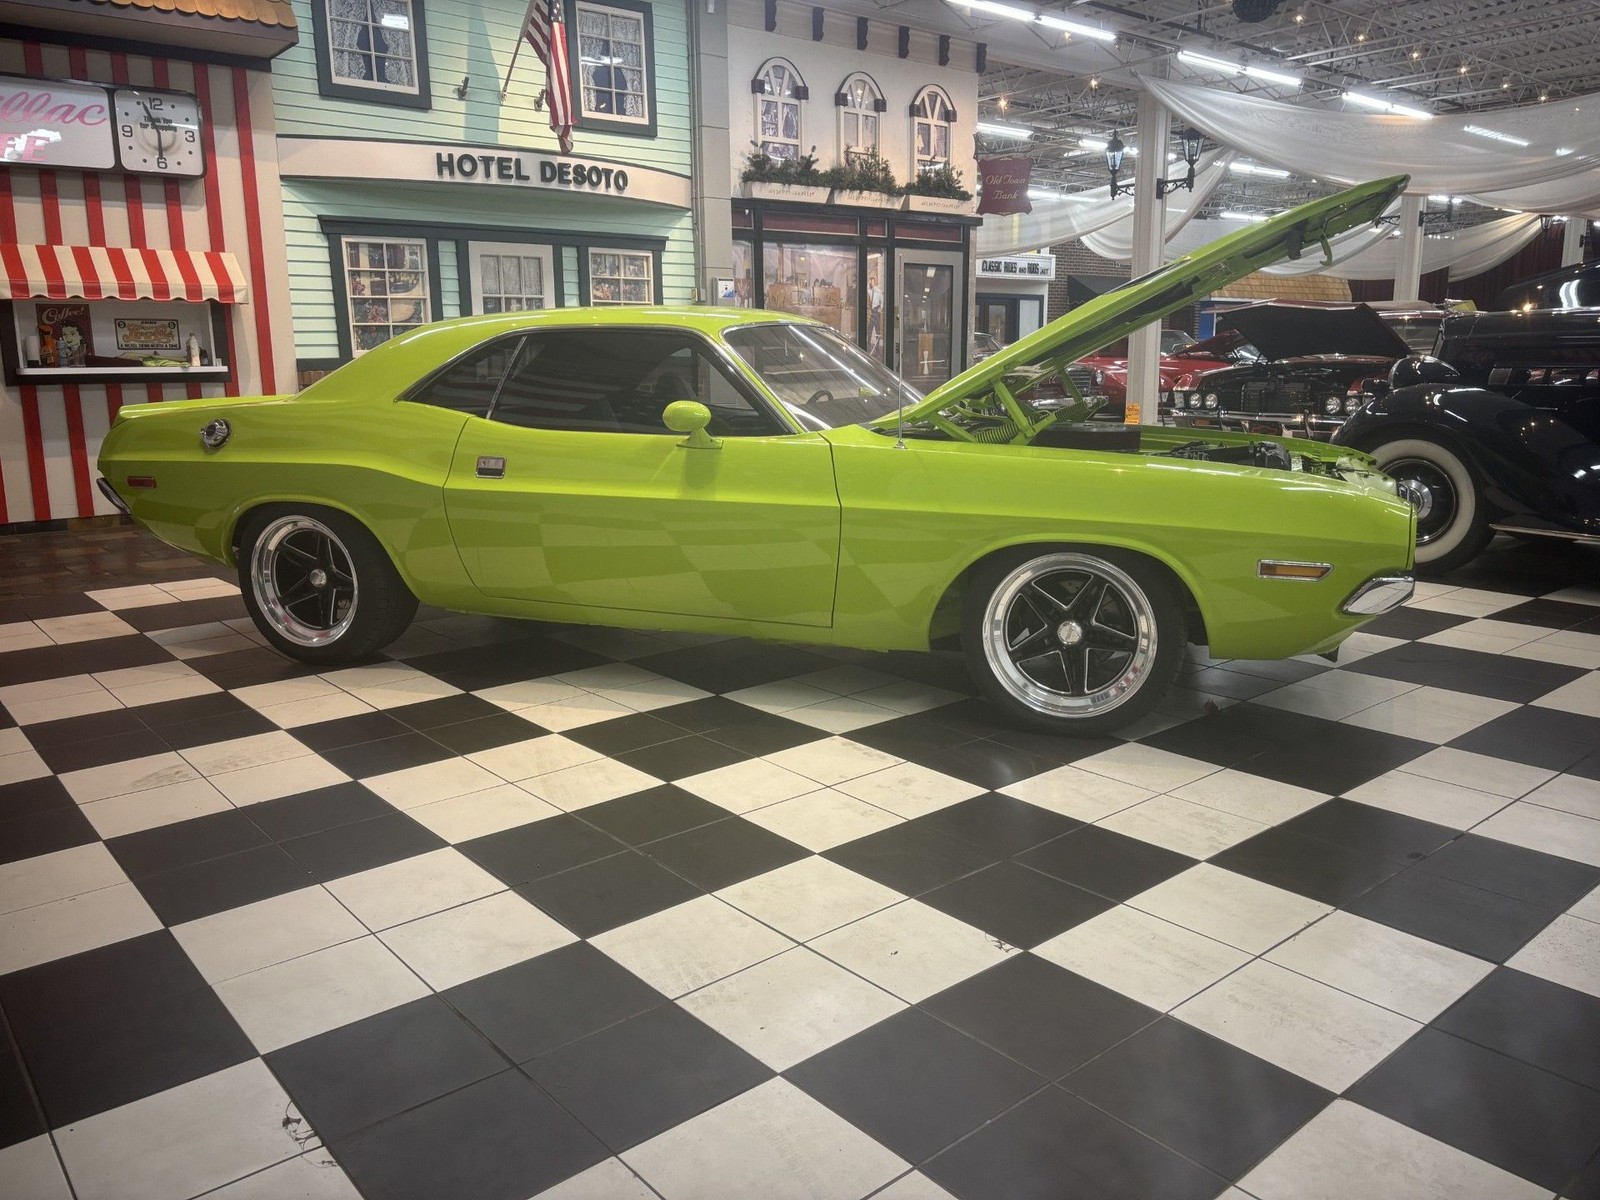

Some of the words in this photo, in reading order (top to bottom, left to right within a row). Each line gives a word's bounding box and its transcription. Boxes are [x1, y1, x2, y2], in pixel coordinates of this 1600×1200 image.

[148, 97, 164, 111] 12
[121, 124, 133, 138] 9
[184, 130, 196, 143] 3
[157, 156, 168, 170] 6
[435, 152, 531, 181] HOTEL
[540, 160, 629, 191] DESOTO
[985, 174, 1002, 185] Old
[1003, 174, 1026, 185] Town
[992, 189, 1018, 200] Bank
